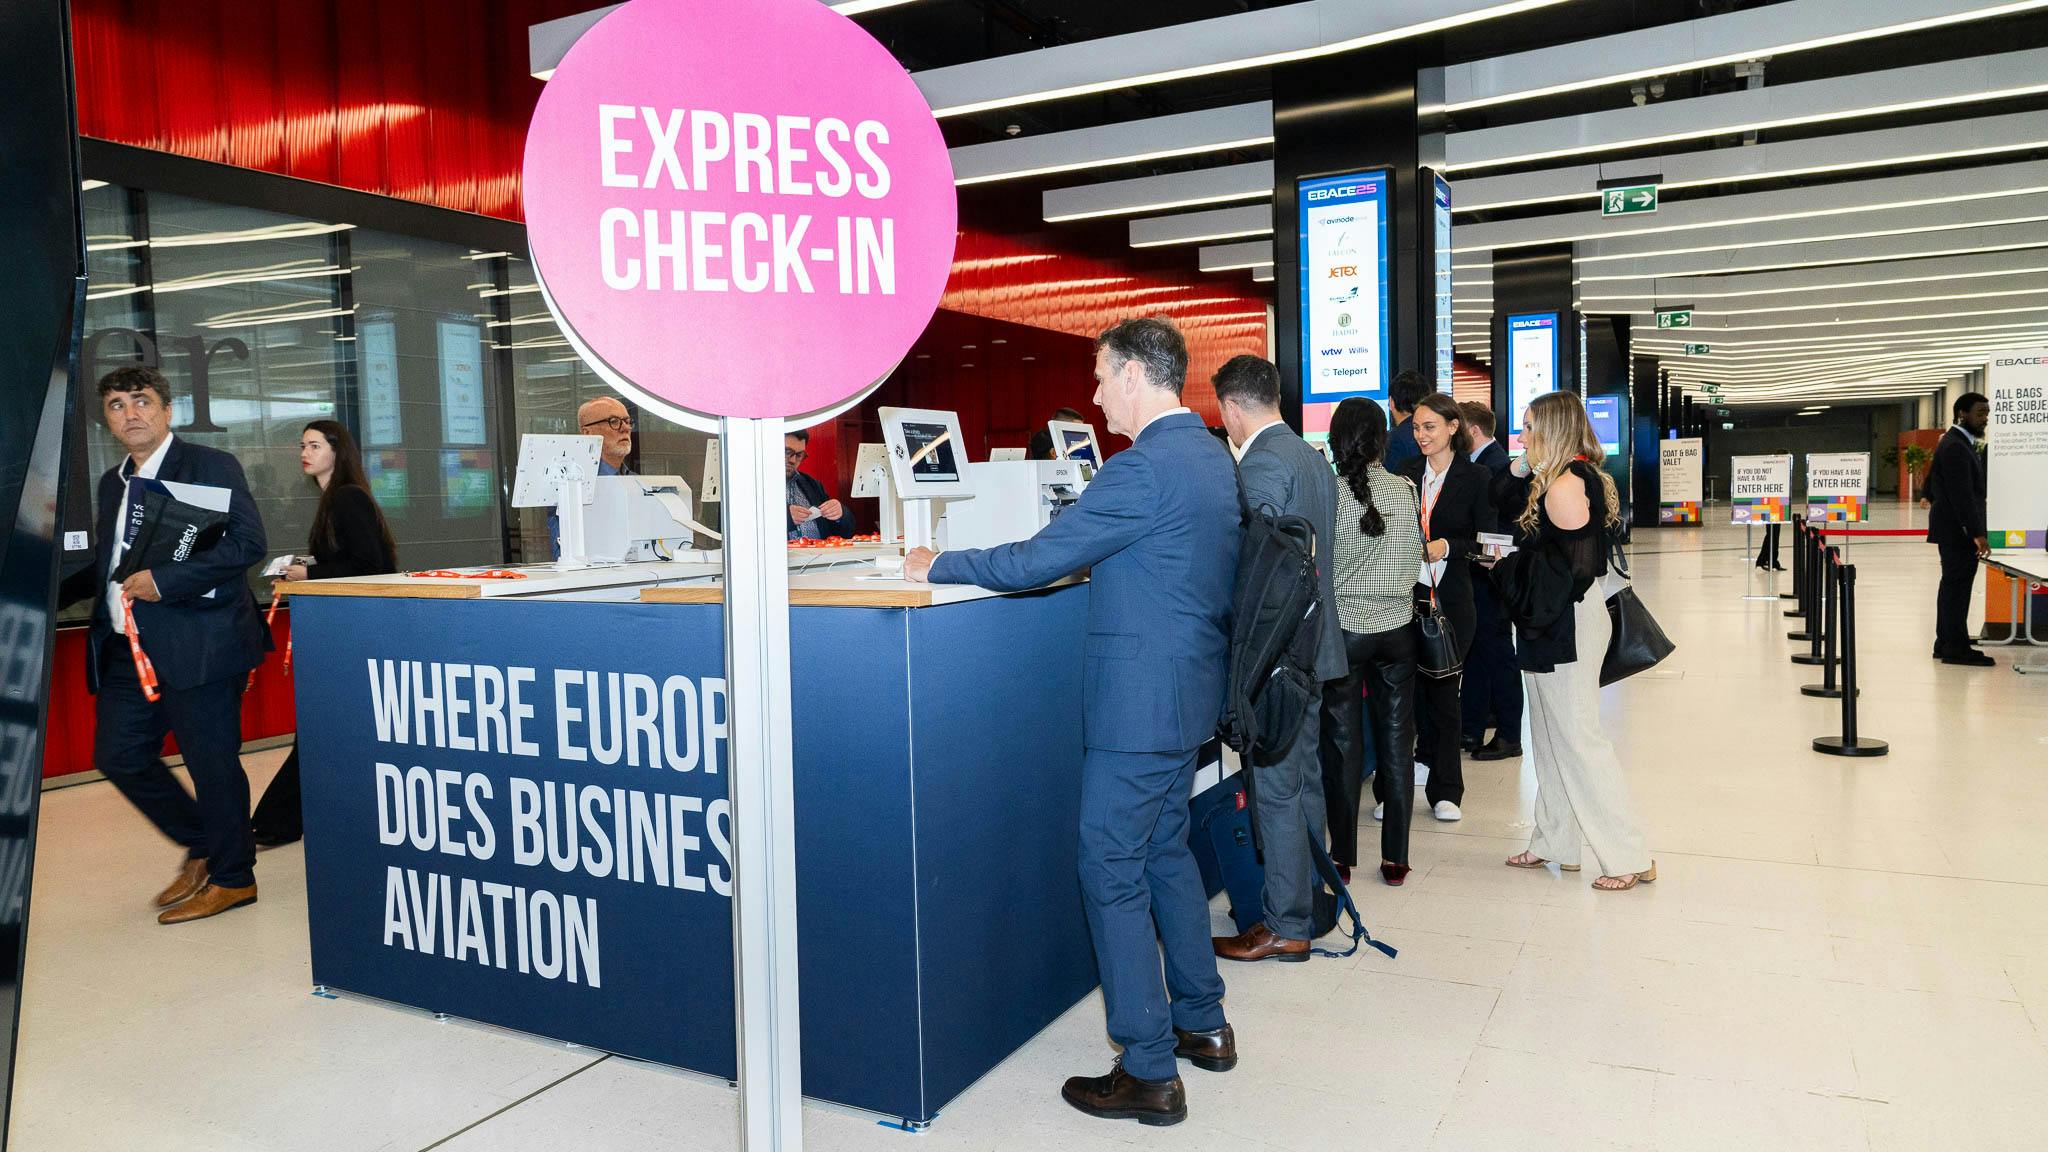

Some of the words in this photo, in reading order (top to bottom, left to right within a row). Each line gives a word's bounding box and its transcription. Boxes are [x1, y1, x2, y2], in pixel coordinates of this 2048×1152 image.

[599, 103, 892, 200] EXPRESS
[1308, 183, 1377, 201] EBACE25
[600, 207, 896, 295] CHECK-IN
[1328, 265, 1357, 279] JETEX
[1321, 347, 1343, 356] wtw
[1332, 367, 1367, 377] Teleport
[1995, 389, 2013, 400] ALL
[2016, 387, 2042, 399] BAGS
[1995, 401, 2015, 412] ARE
[1995, 413, 2007, 425] TO
[1663, 449, 1678, 457] COAT
[1685, 448, 1698, 457] BAG
[1663, 458, 1681, 466] VALET
[1762, 467, 1772, 475] NOT
[1737, 484, 1762, 493] ENTER
[1763, 483, 1784, 493] HERE
[1813, 479, 1839, 488] ENTER
[1840, 479, 1861, 488] HERE
[367, 658, 540, 757] WHERE
[554, 668, 728, 774] EUROP
[375, 762, 496, 861] DOES
[509, 777, 733, 897] BUSINES
[384, 866, 601, 988] AVIATION
